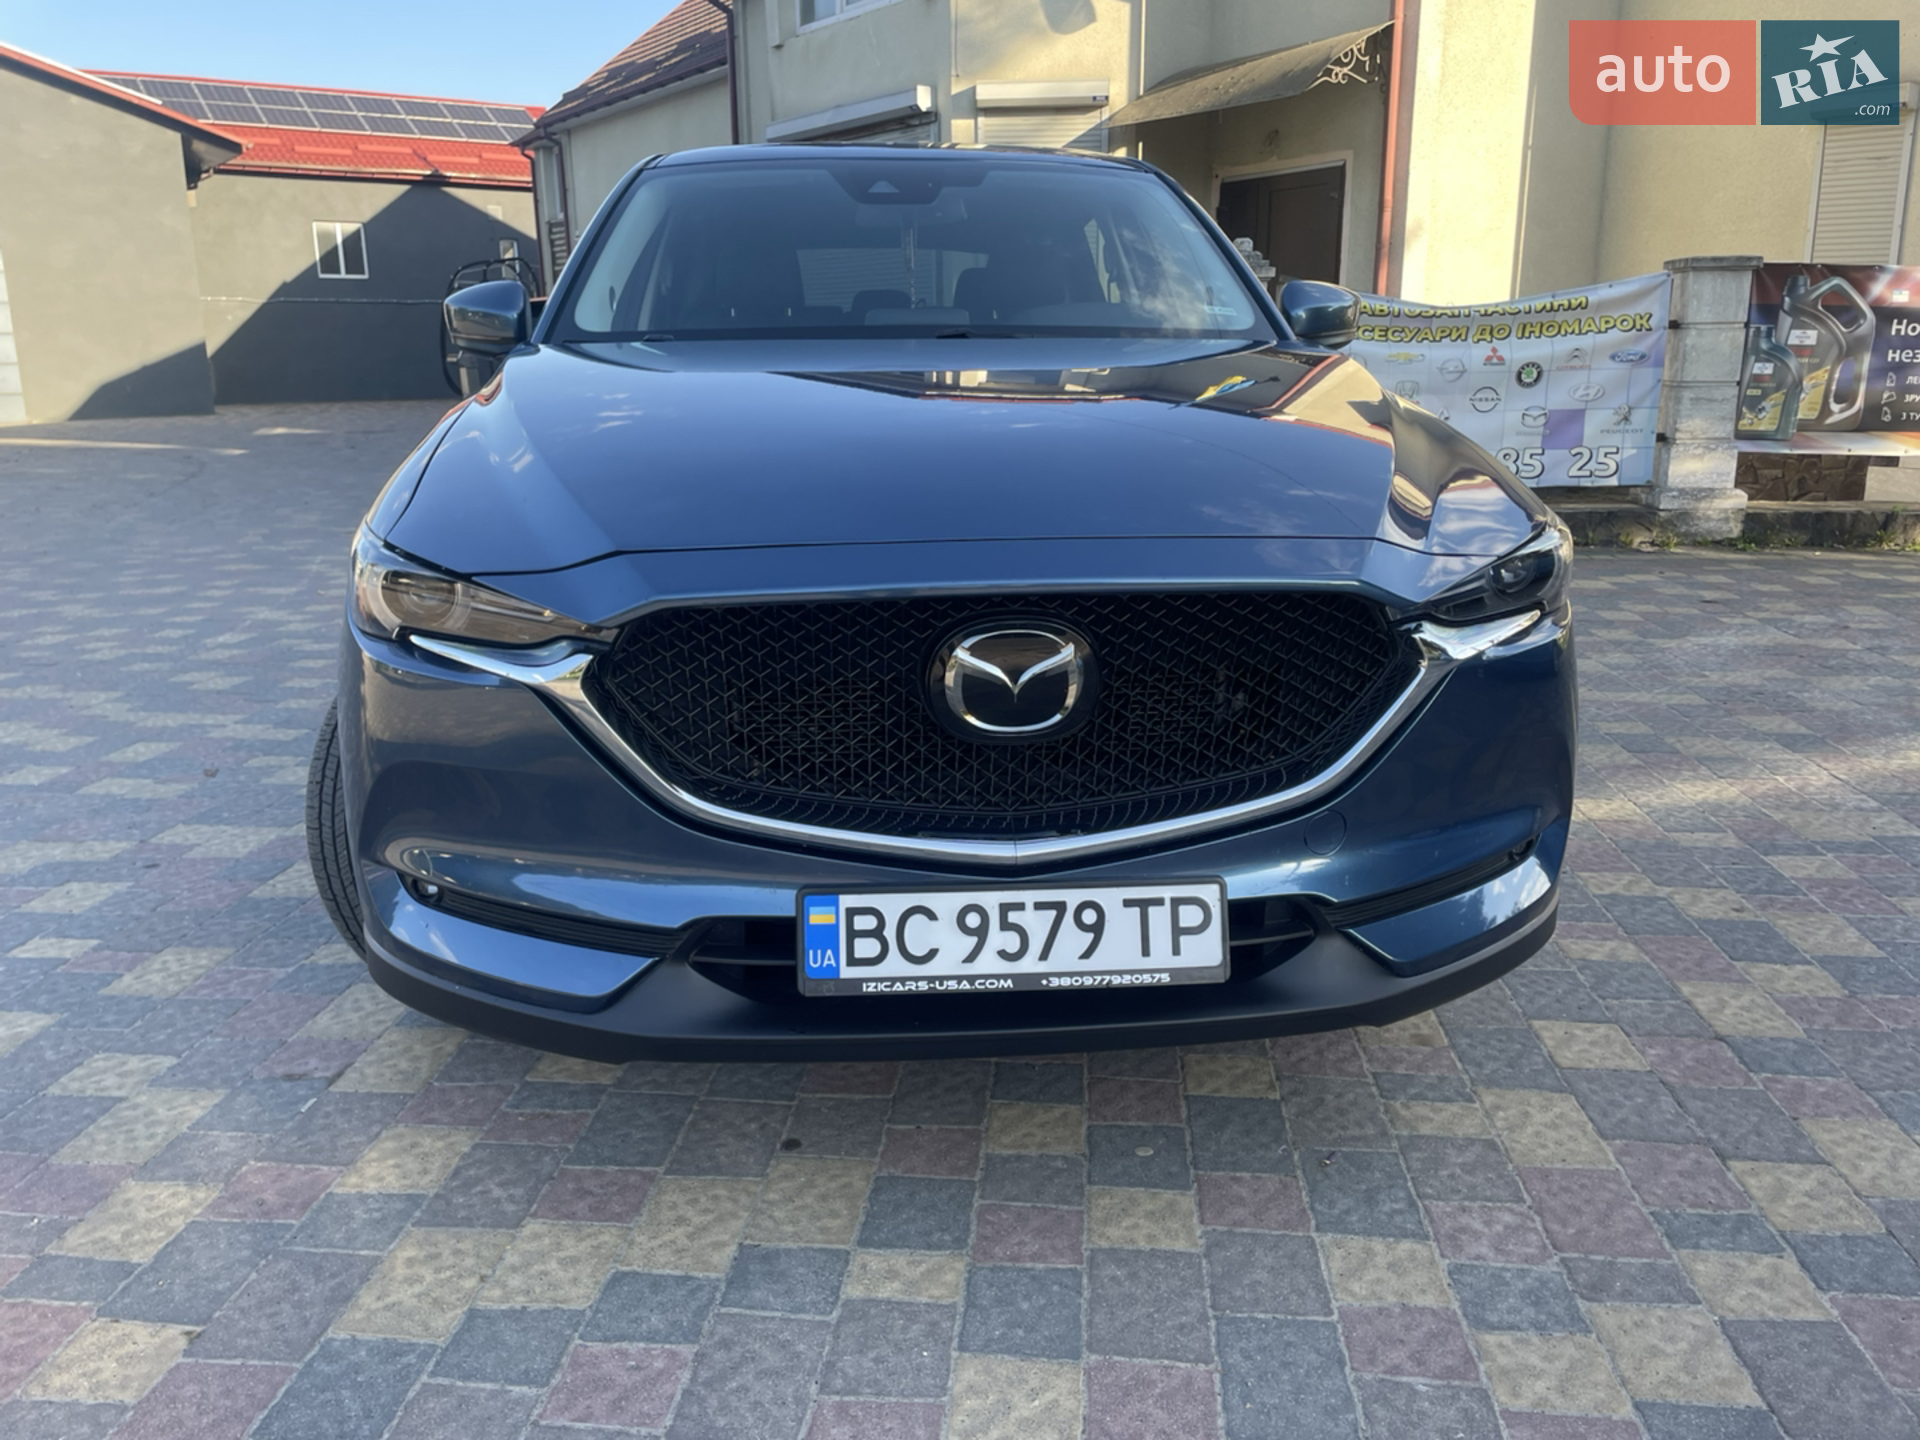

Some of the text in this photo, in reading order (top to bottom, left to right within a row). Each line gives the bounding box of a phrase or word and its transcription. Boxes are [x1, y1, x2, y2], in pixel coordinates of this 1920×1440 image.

[1354, 312, 1652, 344] СЕСУАРИ ДО ІНОМАРОК
[1568, 445, 1620, 479] 25
[845, 895, 1213, 968] BC 9579 TP
[808, 949, 836, 968] UA
[862, 972, 1171, 993] IZICARS-USA.COM +380977920575
